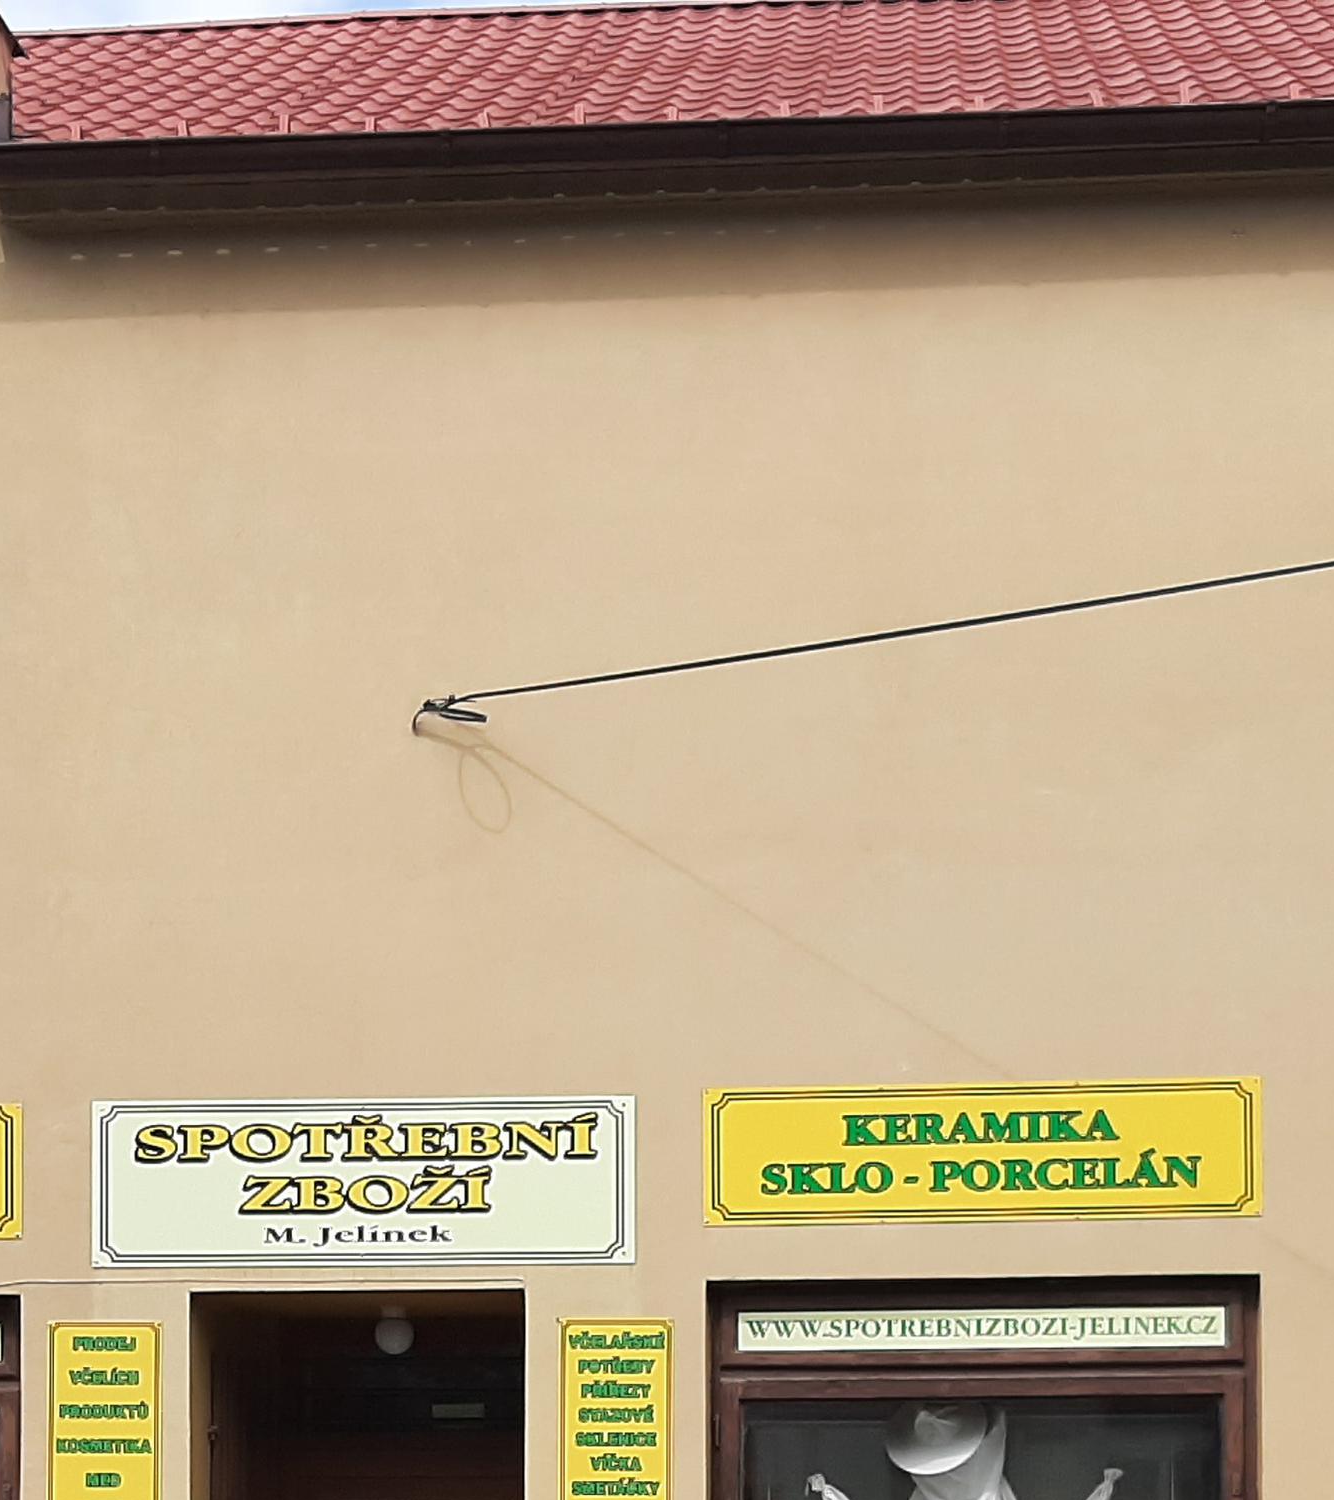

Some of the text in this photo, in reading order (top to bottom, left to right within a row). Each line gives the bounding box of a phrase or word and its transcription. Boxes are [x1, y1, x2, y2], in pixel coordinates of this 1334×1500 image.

[134, 1112, 601, 1163] SPOTŘEBNÍ
[843, 1110, 1117, 1146] KERAMIKA
[761, 1161, 893, 1195] SKLO
[930, 1148, 1202, 1193] PORCELÁN
[239, 1165, 493, 1215] ZBOŽÍ
[264, 1223, 453, 1247] M. Jelínek
[746, 1314, 1218, 1339] WWW.SPOTREBNIZBOZI-JELINEK.CZ
[73, 1336, 136, 1351] PRODEJ
[578, 1356, 655, 1374] POTŘEBY
[86, 1473, 121, 1487] MED
